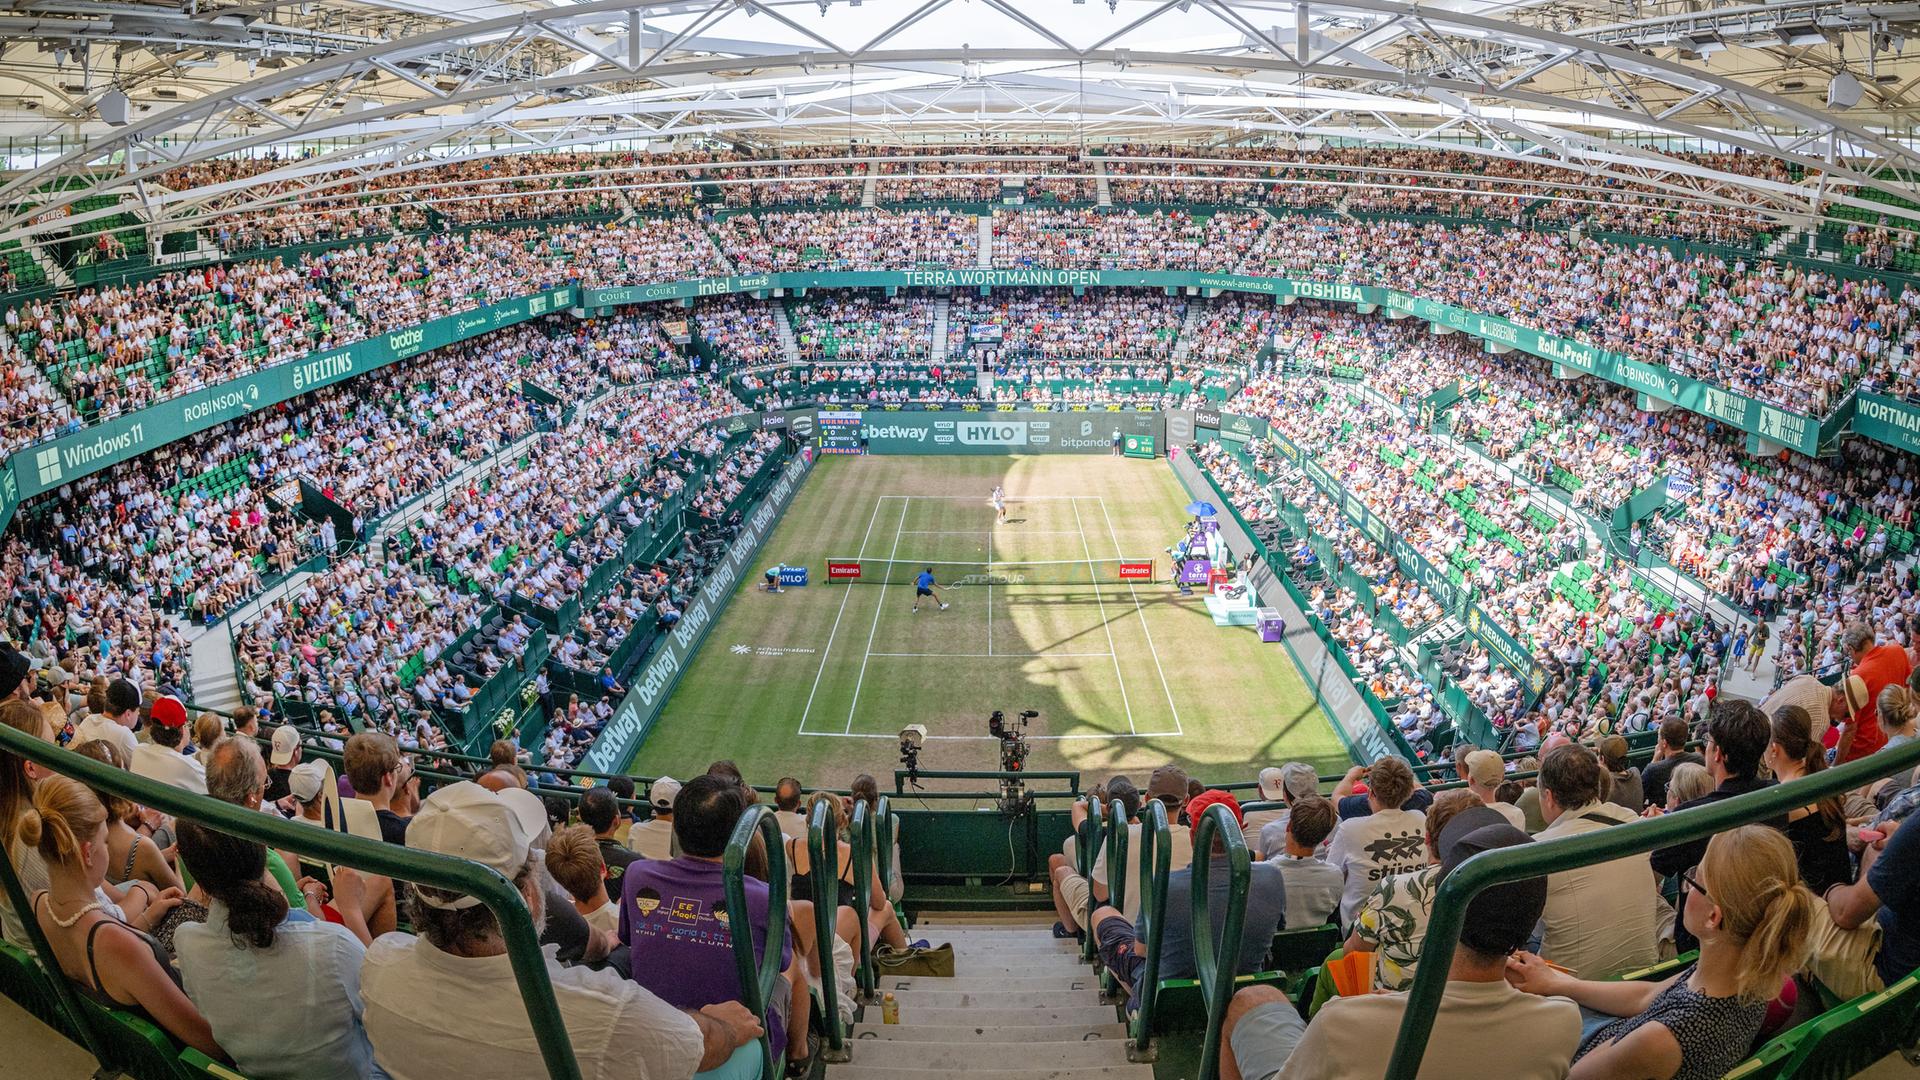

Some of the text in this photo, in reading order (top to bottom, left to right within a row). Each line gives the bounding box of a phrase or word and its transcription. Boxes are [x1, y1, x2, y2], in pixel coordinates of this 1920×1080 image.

[739, 278, 760, 287] terra
[904, 271, 1100, 285] TERRA WORTMANN OPEN
[1199, 277, 1274, 291] www.owl-arena.de
[1291, 281, 1364, 301] TOSHIBA
[1392, 293, 1415, 312] VELTINS
[390, 329, 424, 350] brother
[303, 352, 353, 385] VELTINS
[1617, 363, 1665, 391] ROBINSON
[184, 390, 244, 422] ROBINSON
[1725, 392, 1747, 412] BRUNO
[762, 416, 785, 425] Haier
[1195, 413, 1220, 425] Haier
[1724, 404, 1744, 426] KLEINE
[1781, 412, 1805, 432] BRUNO
[869, 425, 928, 442] betway
[1061, 438, 1111, 448] bitpanda
[1780, 427, 1802, 448] KLEINE
[64, 422, 144, 469] Windows 11
[770, 477, 792, 506] betway
[751, 501, 775, 533] betway
[730, 528, 757, 565] betway
[1120, 567, 1150, 575] Emirates
[704, 560, 735, 604] betway
[673, 598, 710, 649] betway
[1481, 621, 1531, 675] MERKUR.COM
[634, 645, 679, 706] betway
[1310, 651, 1351, 709] betway
[589, 702, 642, 774] betway
[672, 909, 698, 920] Magic
[678, 902, 695, 911] EE
[672, 926, 698, 937] world
[690, 938, 733, 948] ALUMN
